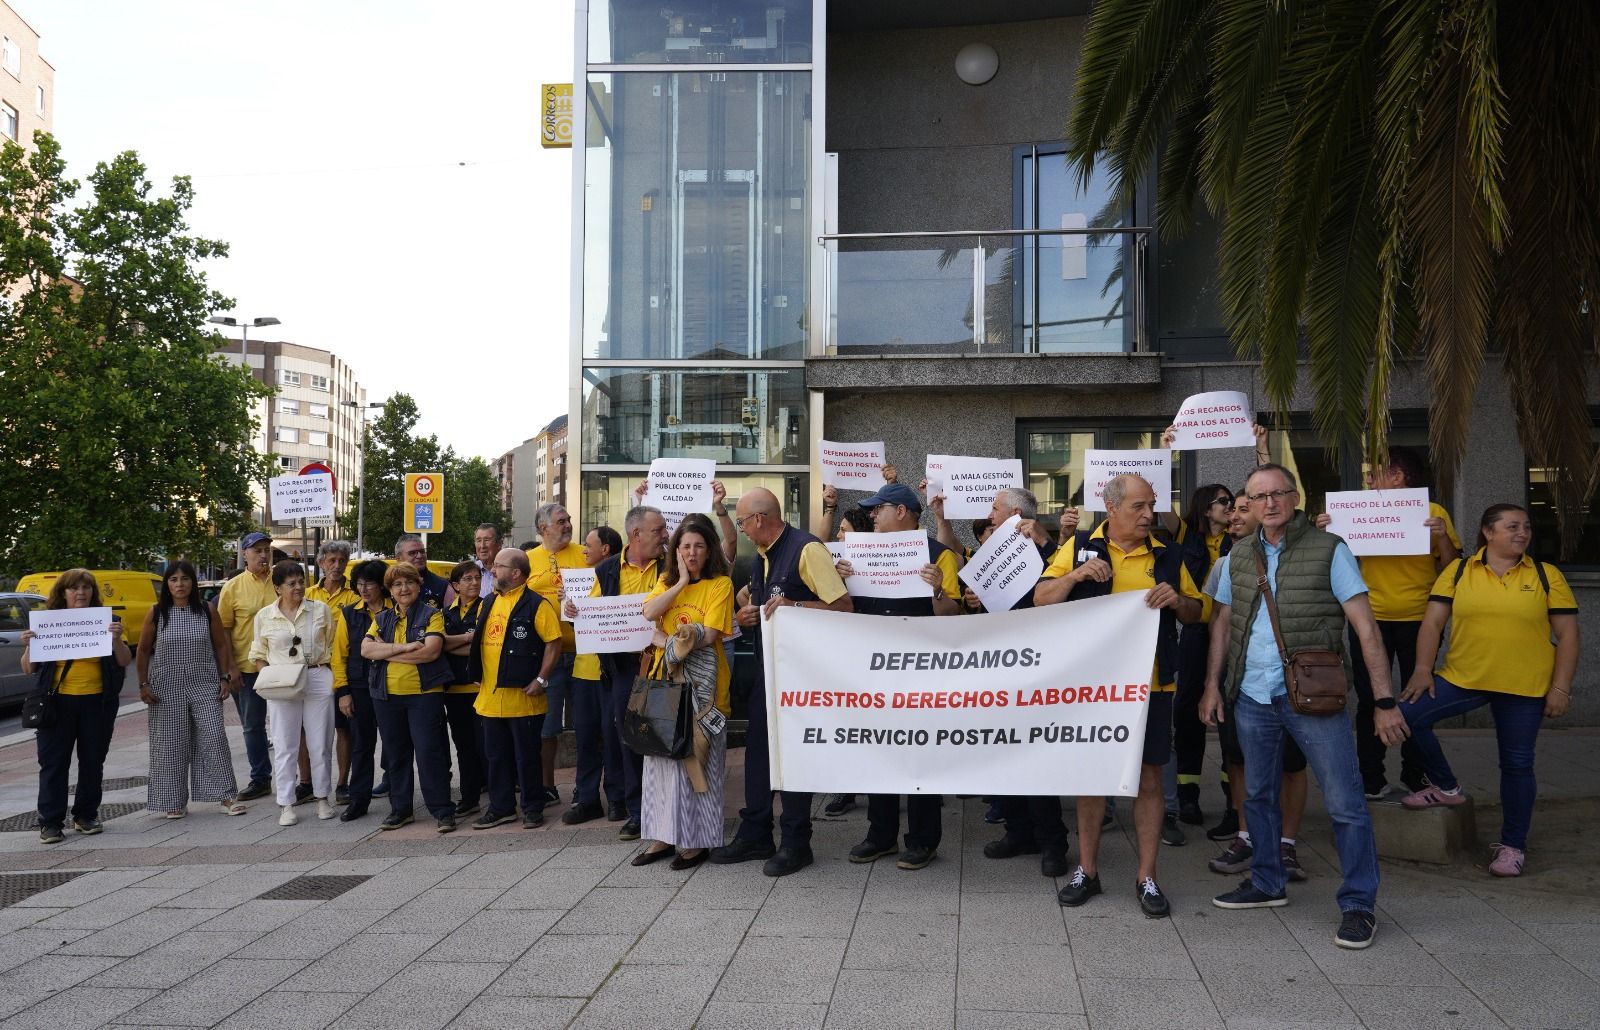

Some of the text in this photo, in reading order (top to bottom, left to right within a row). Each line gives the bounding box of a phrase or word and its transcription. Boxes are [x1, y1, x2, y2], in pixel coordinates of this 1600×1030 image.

[1198, 405, 1241, 414] RECARGOS
[823, 459, 853, 467] SERVICIO
[824, 450, 868, 458] DEFENDAMOS
[982, 470, 1014, 479] GESTIÓN
[973, 572, 982, 582] LA
[980, 556, 996, 574] MALA
[982, 542, 1028, 590] NO ES CULPA DEL
[998, 561, 1027, 590] CARTERO
[870, 648, 1041, 671] DEFENDAMOS:
[780, 683, 1149, 709] NUESTROS DERECHOS LABORALES
[803, 722, 1130, 746] EL SERVICIO POSTAL PÚBLICO
